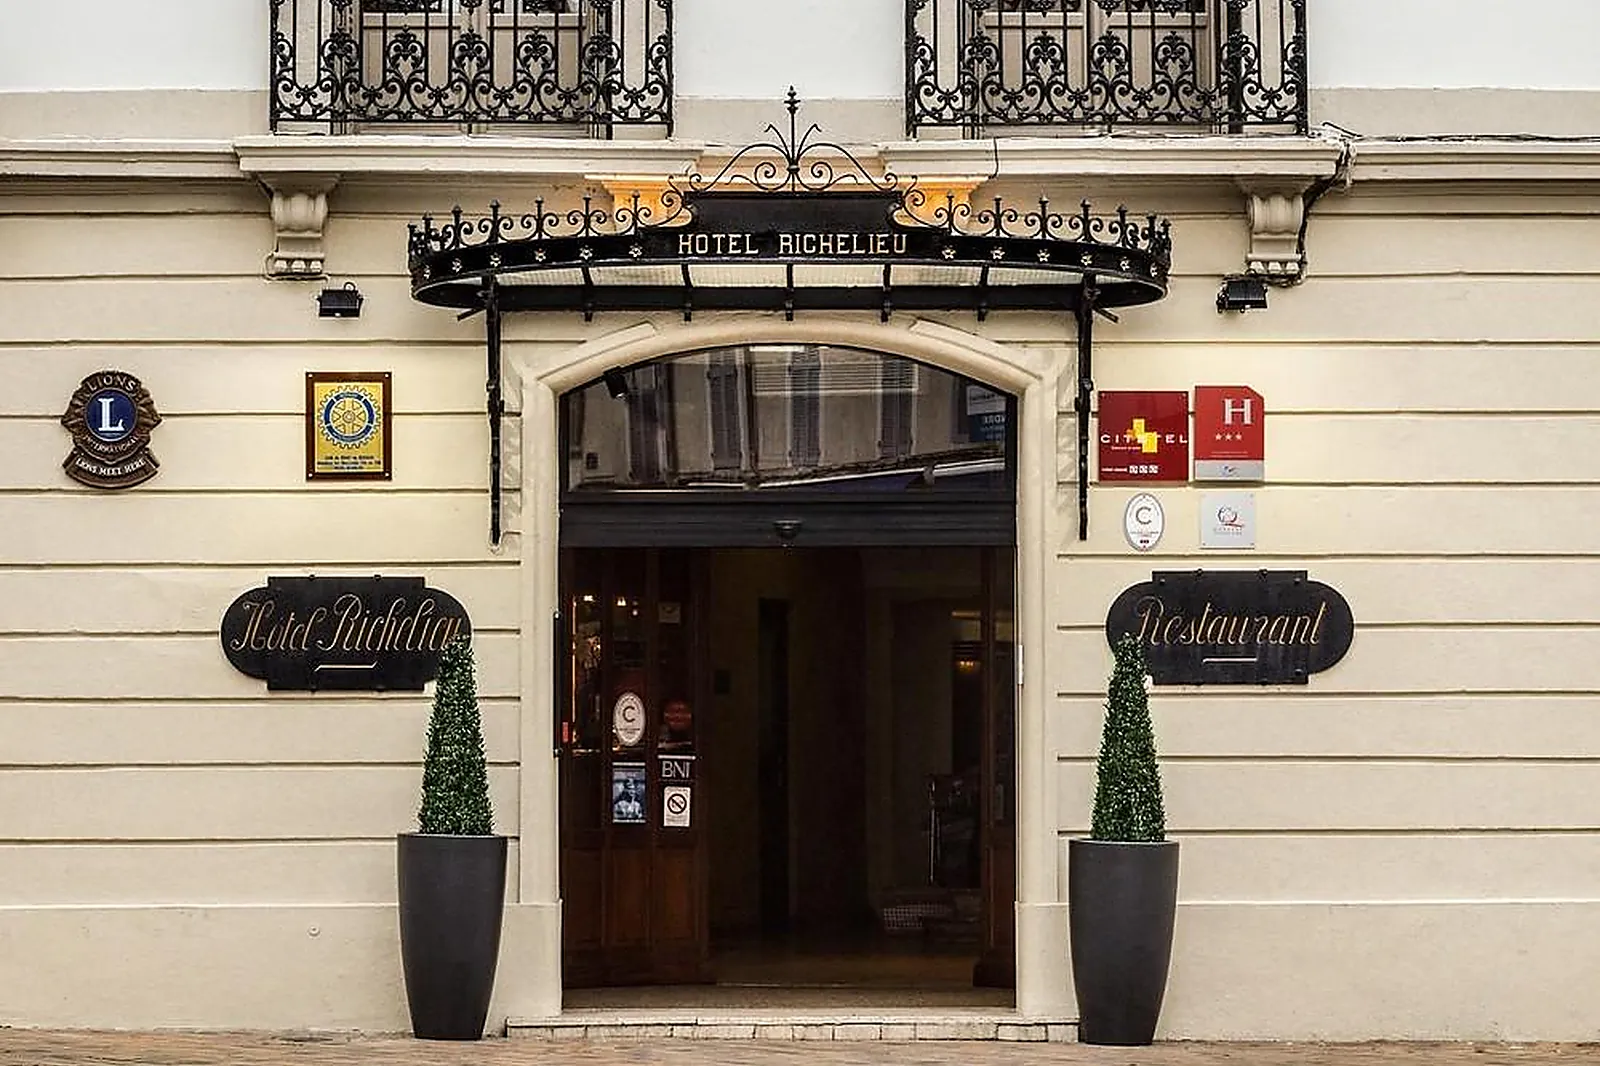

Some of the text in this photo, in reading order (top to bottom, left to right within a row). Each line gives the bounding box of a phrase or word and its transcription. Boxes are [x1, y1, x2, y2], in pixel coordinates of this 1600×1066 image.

[678, 233, 908, 255] HOTEL RICHELIEU
[85, 374, 137, 392] LIONS
[97, 397, 125, 432] L
[1223, 398, 1252, 425] H
[1134, 595, 1327, 646] Restaurant
[661, 760, 691, 779] BNI
